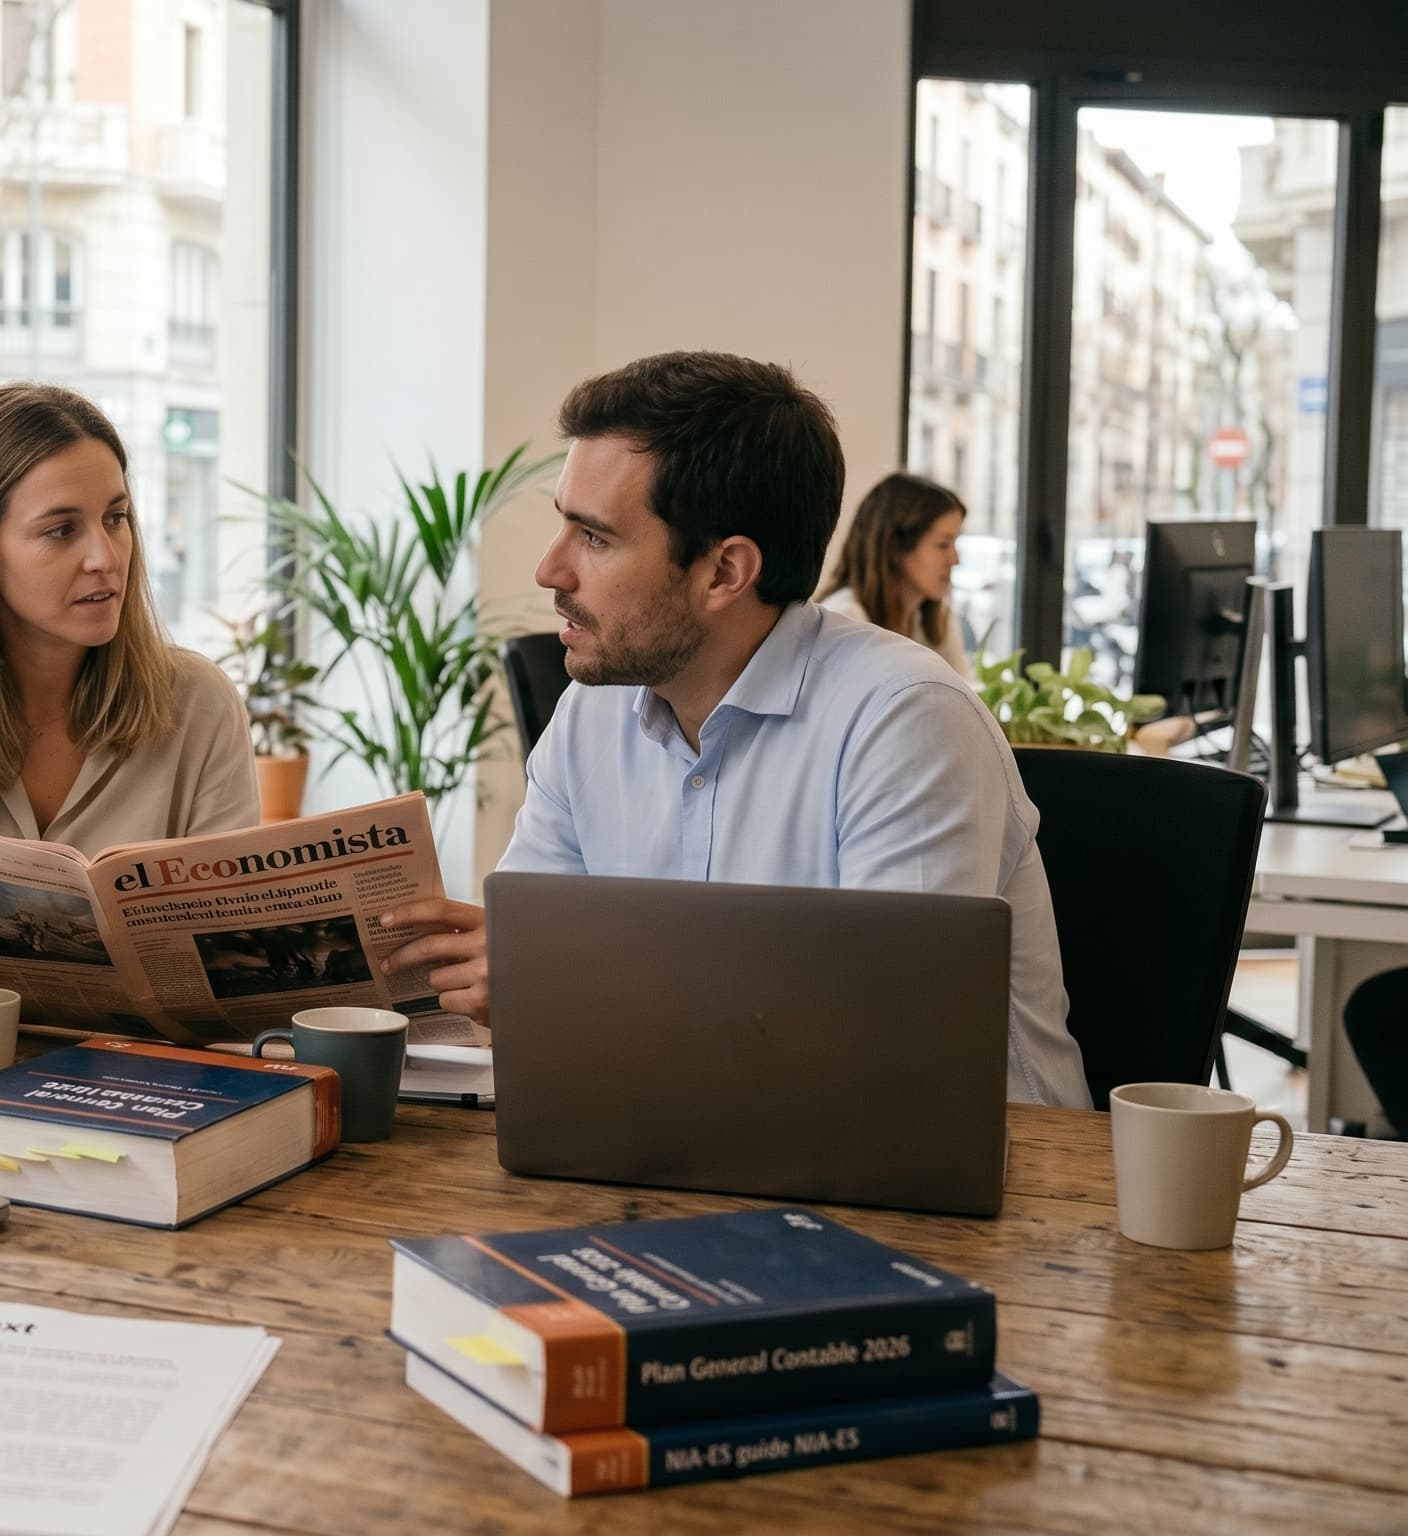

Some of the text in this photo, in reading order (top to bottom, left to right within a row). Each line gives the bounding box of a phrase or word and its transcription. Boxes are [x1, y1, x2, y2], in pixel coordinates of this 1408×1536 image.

[114, 862, 153, 892] el
[154, 823, 412, 887] Economista
[130, 1103, 188, 1119] Plan
[640, 1359, 687, 1385] Plan
[689, 1350, 769, 1381] General
[771, 1340, 859, 1372] Contable
[862, 1334, 912, 1361] 2026
[665, 1442, 733, 1473] NIA-ES
[735, 1436, 791, 1469] guide
[793, 1426, 861, 1455] NIA-ES
